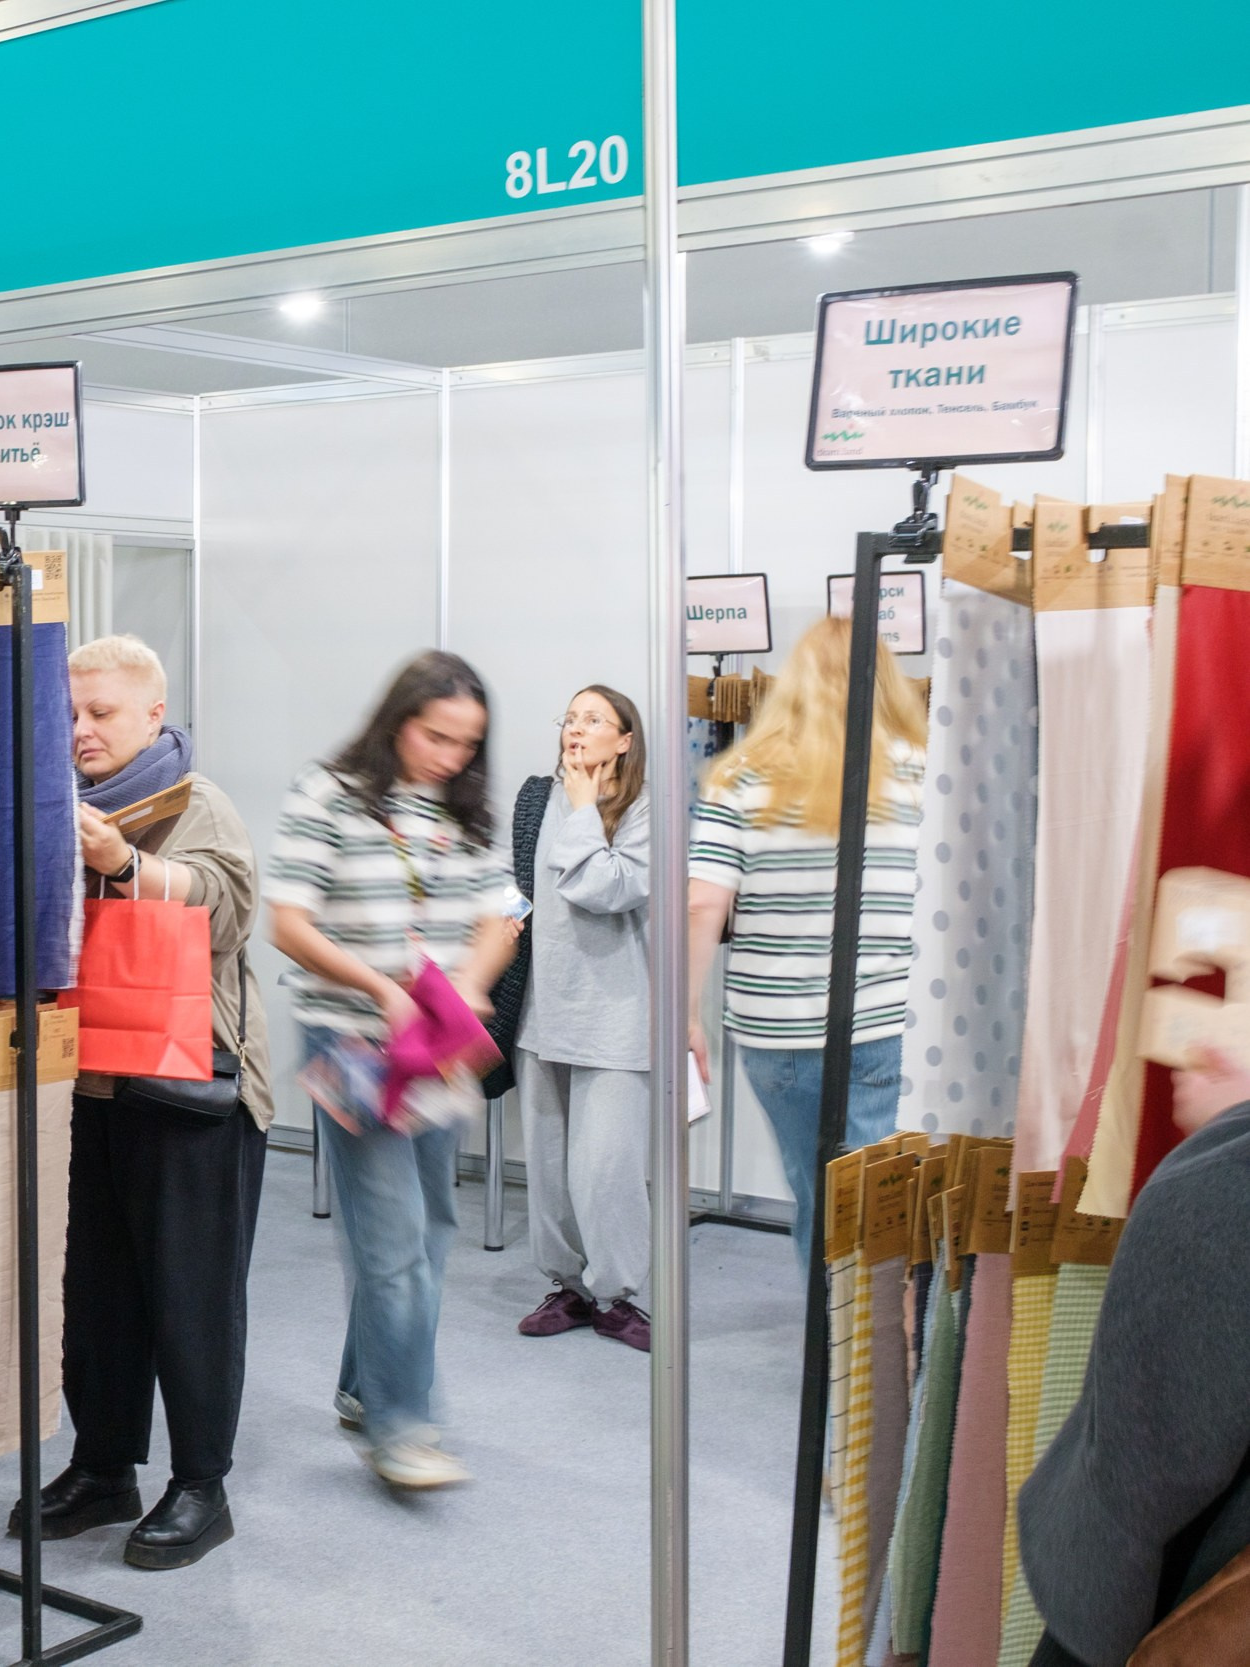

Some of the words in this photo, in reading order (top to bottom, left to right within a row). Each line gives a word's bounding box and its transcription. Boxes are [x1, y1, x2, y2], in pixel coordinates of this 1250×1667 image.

[505, 134, 629, 199] 8L20
[863, 315, 1022, 348] Широкие
[888, 364, 987, 389] ткани
[22, 411, 70, 433] крэш
[686, 604, 748, 624] Шерпа
